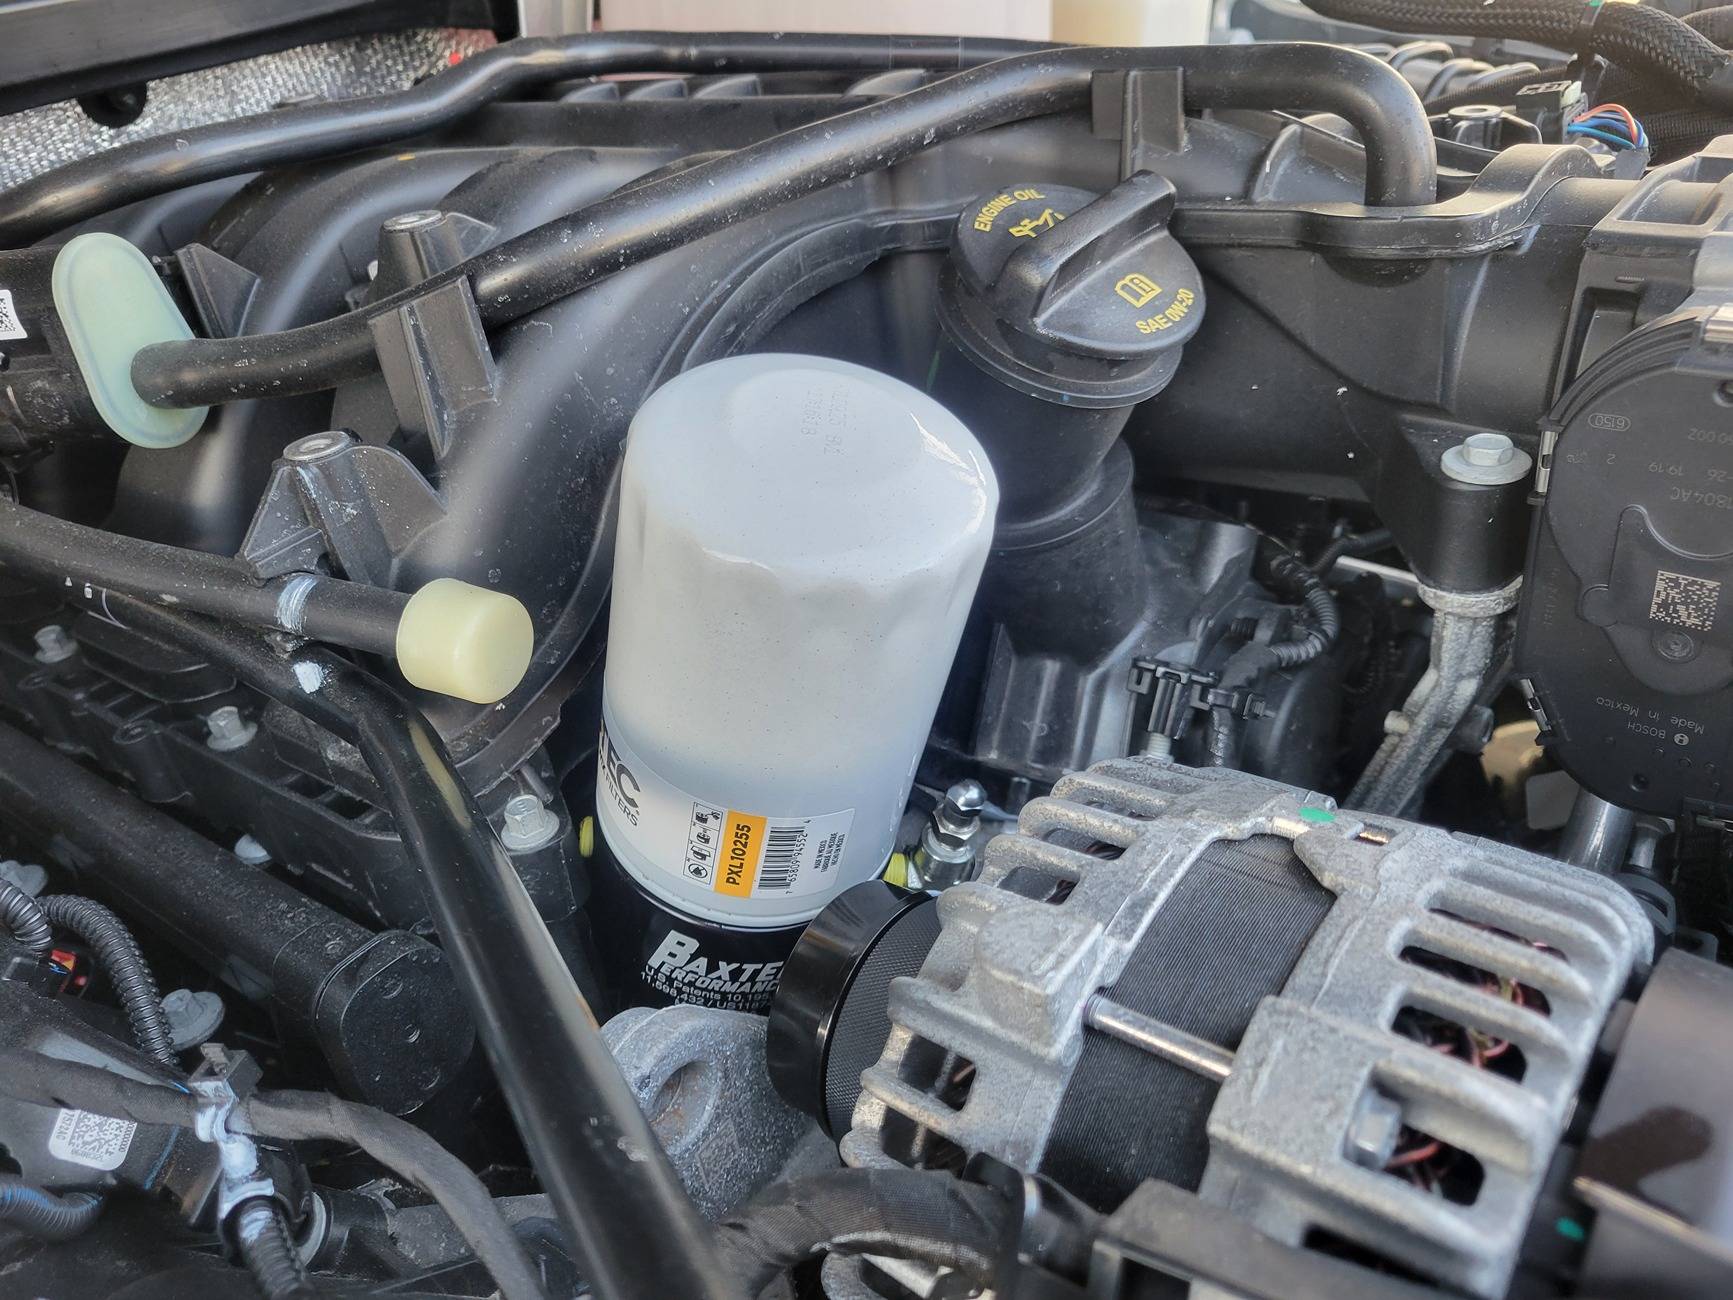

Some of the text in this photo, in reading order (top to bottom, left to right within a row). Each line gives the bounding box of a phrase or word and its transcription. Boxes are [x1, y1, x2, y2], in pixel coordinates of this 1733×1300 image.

[974, 188, 1046, 232] ENGINE OIL
[1135, 287, 1195, 334] SAE 0W-20
[1594, 415, 1626, 430] 6150
[1596, 696, 1705, 735] Made in Mexico
[1627, 721, 1666, 739] BOSCH
[725, 823, 752, 886] PXL10255
[647, 929, 784, 982] BAXTE
[645, 964, 669, 985] U.S.
[673, 980, 721, 1000] Patents
